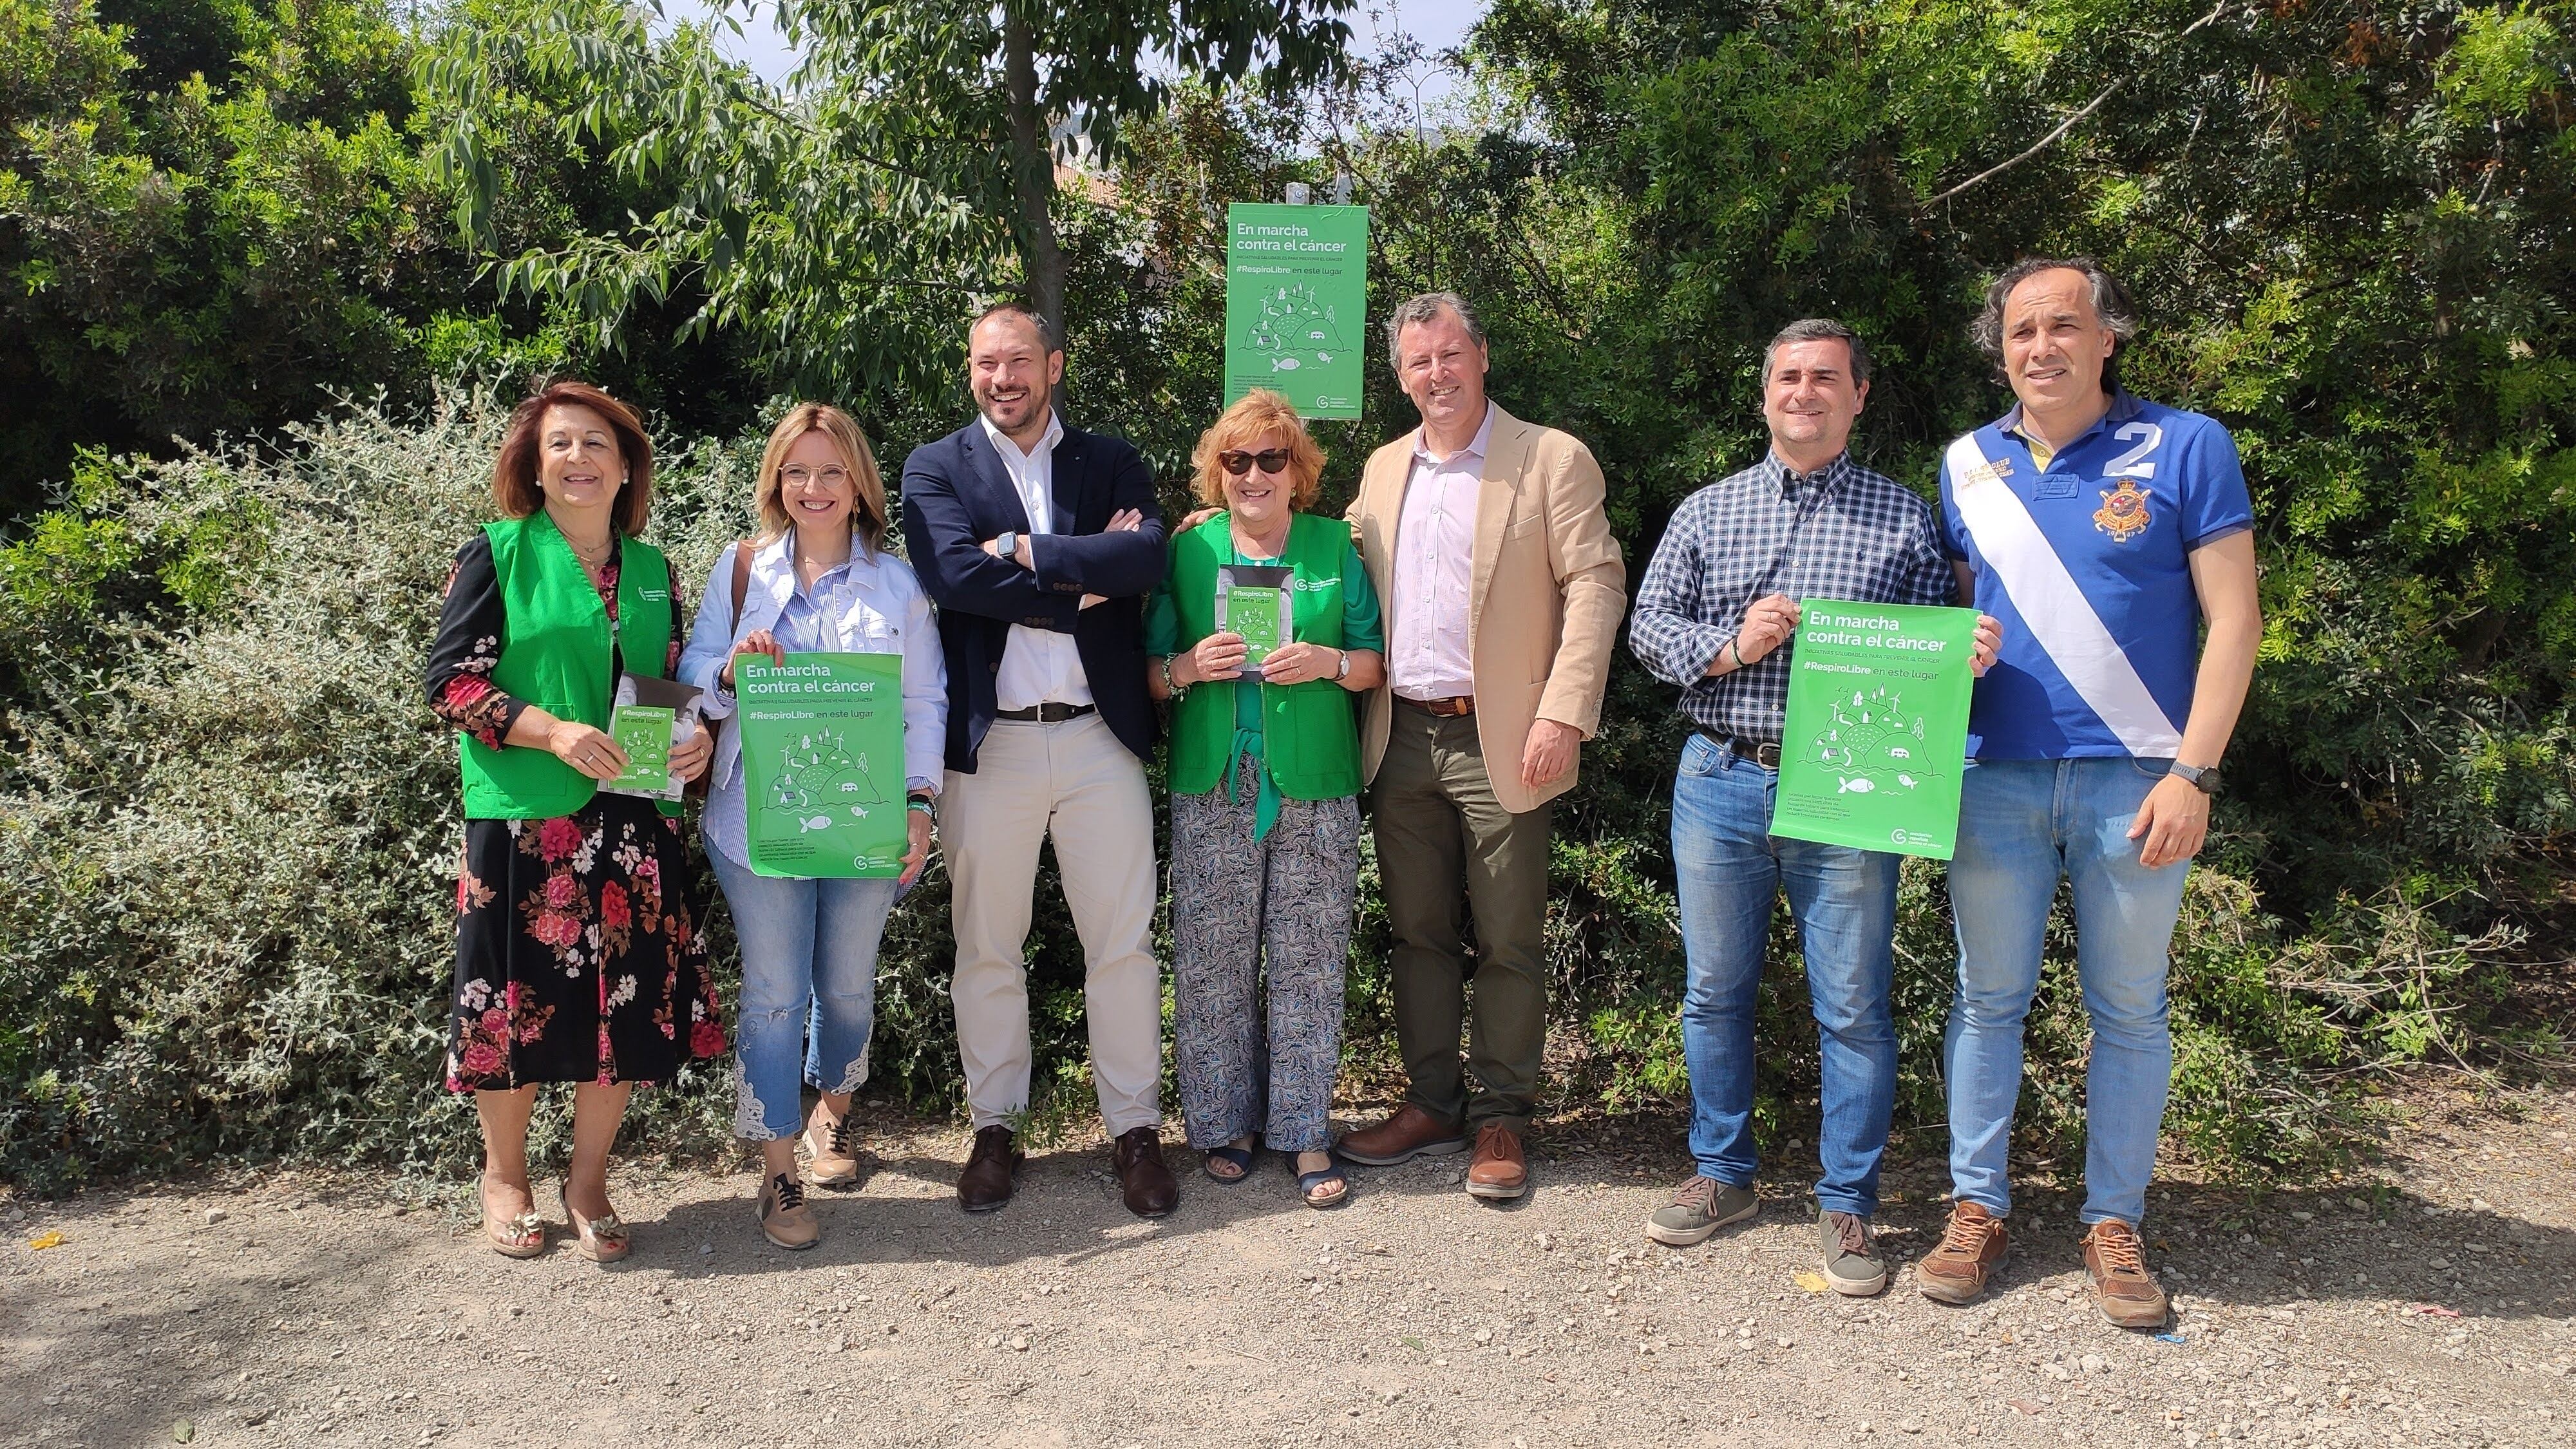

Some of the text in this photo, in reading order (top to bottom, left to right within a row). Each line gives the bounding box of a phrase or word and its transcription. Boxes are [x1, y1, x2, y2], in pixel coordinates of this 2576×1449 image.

[1237, 223, 1309, 236] En marcha
[1236, 239, 1347, 252] contra el cáncer
[1236, 265, 1291, 275] #RespiroLibre
[1322, 267, 1343, 276] lugar
[2102, 421, 2163, 480] 2
[1810, 611, 1899, 631] En marcha
[1807, 630, 1947, 652] contra el cáncer
[746, 663, 831, 677] En marcha
[1803, 661, 1939, 681] #RespiroLibre en este lugar
[748, 679, 875, 694] contra el cáncer
[750, 710, 815, 721] #RespiroLibre
[851, 710, 874, 719] lugar
